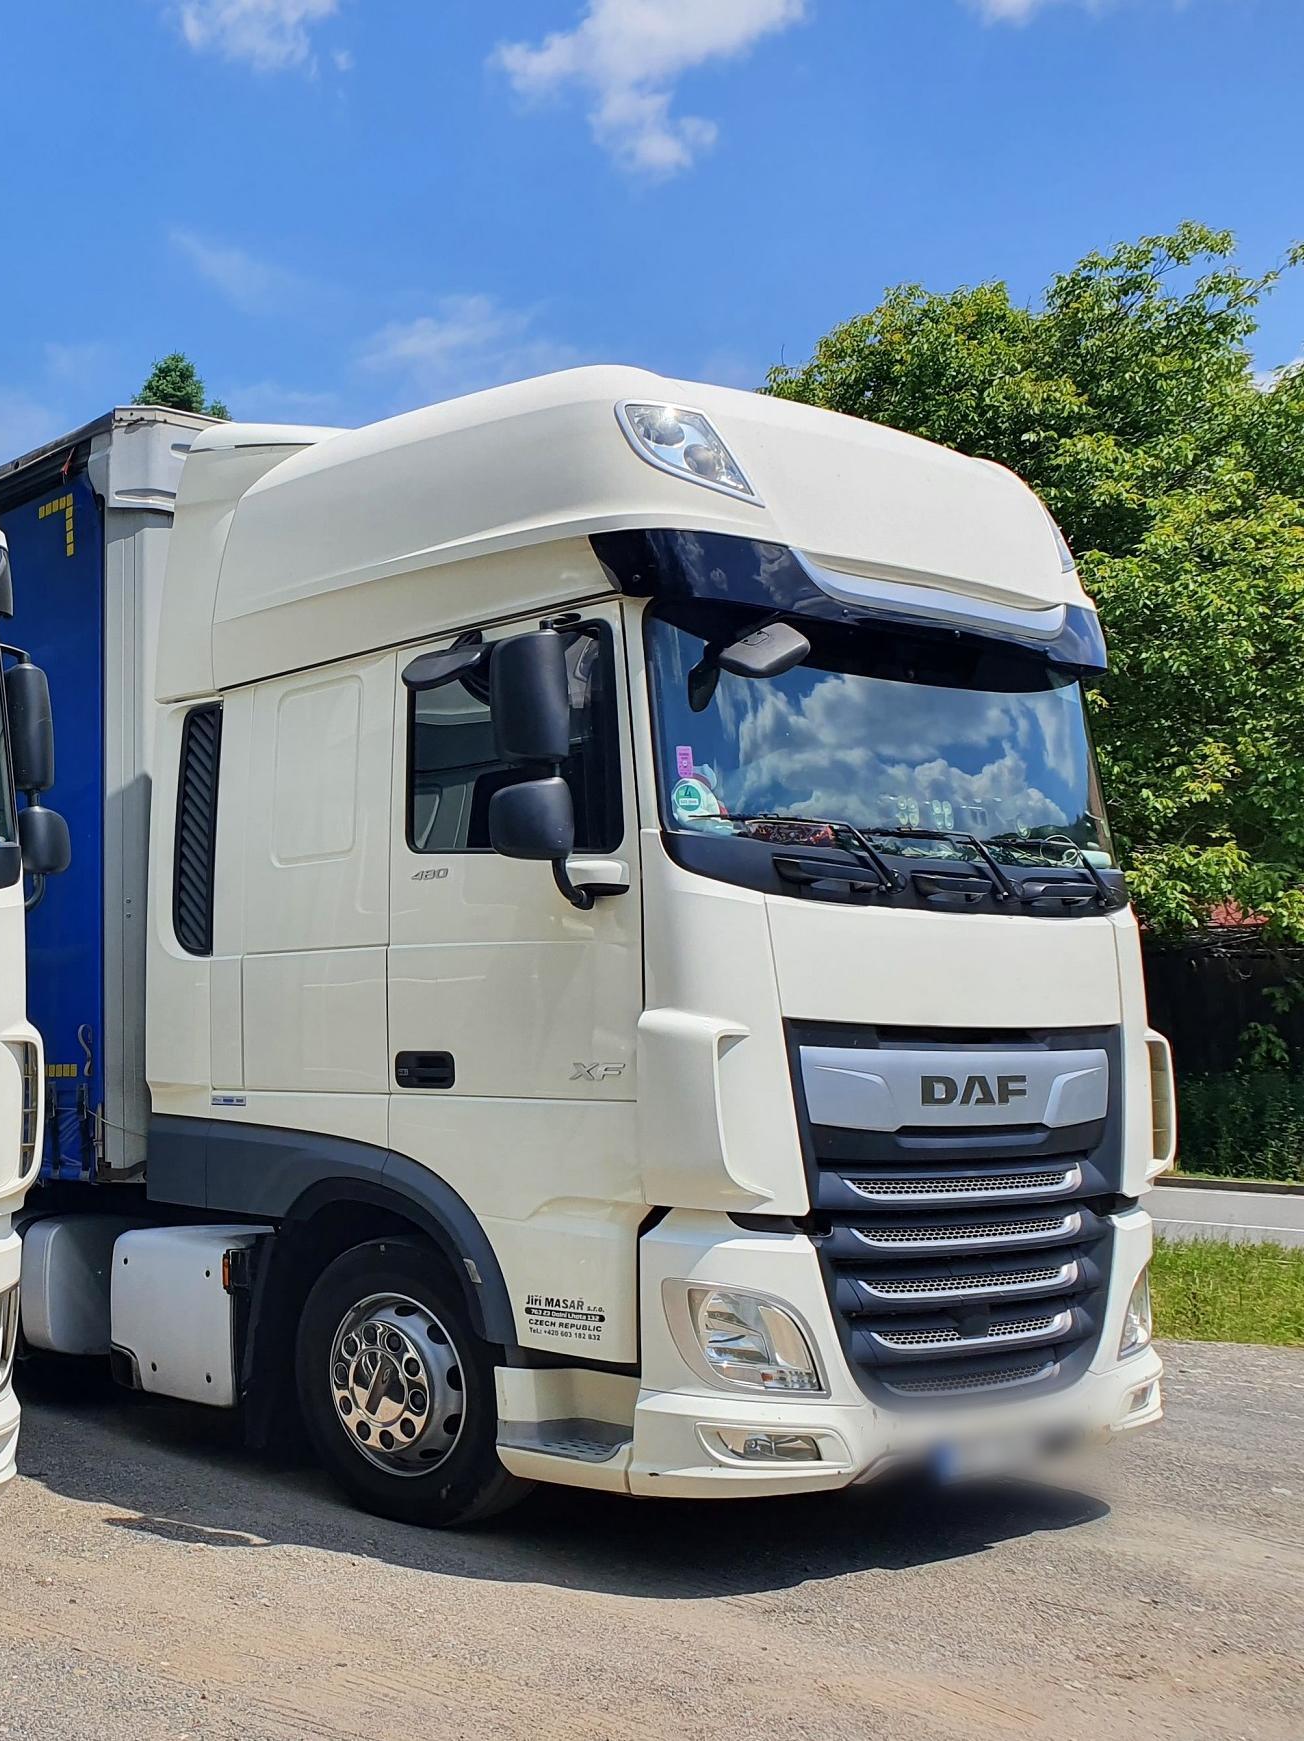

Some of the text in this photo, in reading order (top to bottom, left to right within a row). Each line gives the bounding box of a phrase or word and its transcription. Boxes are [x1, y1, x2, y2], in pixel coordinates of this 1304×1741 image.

[684, 786, 692, 798] 4
[411, 868, 449, 880] 480
[569, 1063, 626, 1081] XF
[920, 1075, 1028, 1106] DAF
[545, 1297, 585, 1310] MASAŘ
[528, 1319, 602, 1332] CZECH REPUBLIC
[543, 1329, 559, 1337] +420
[574, 1332, 586, 1340] 182
